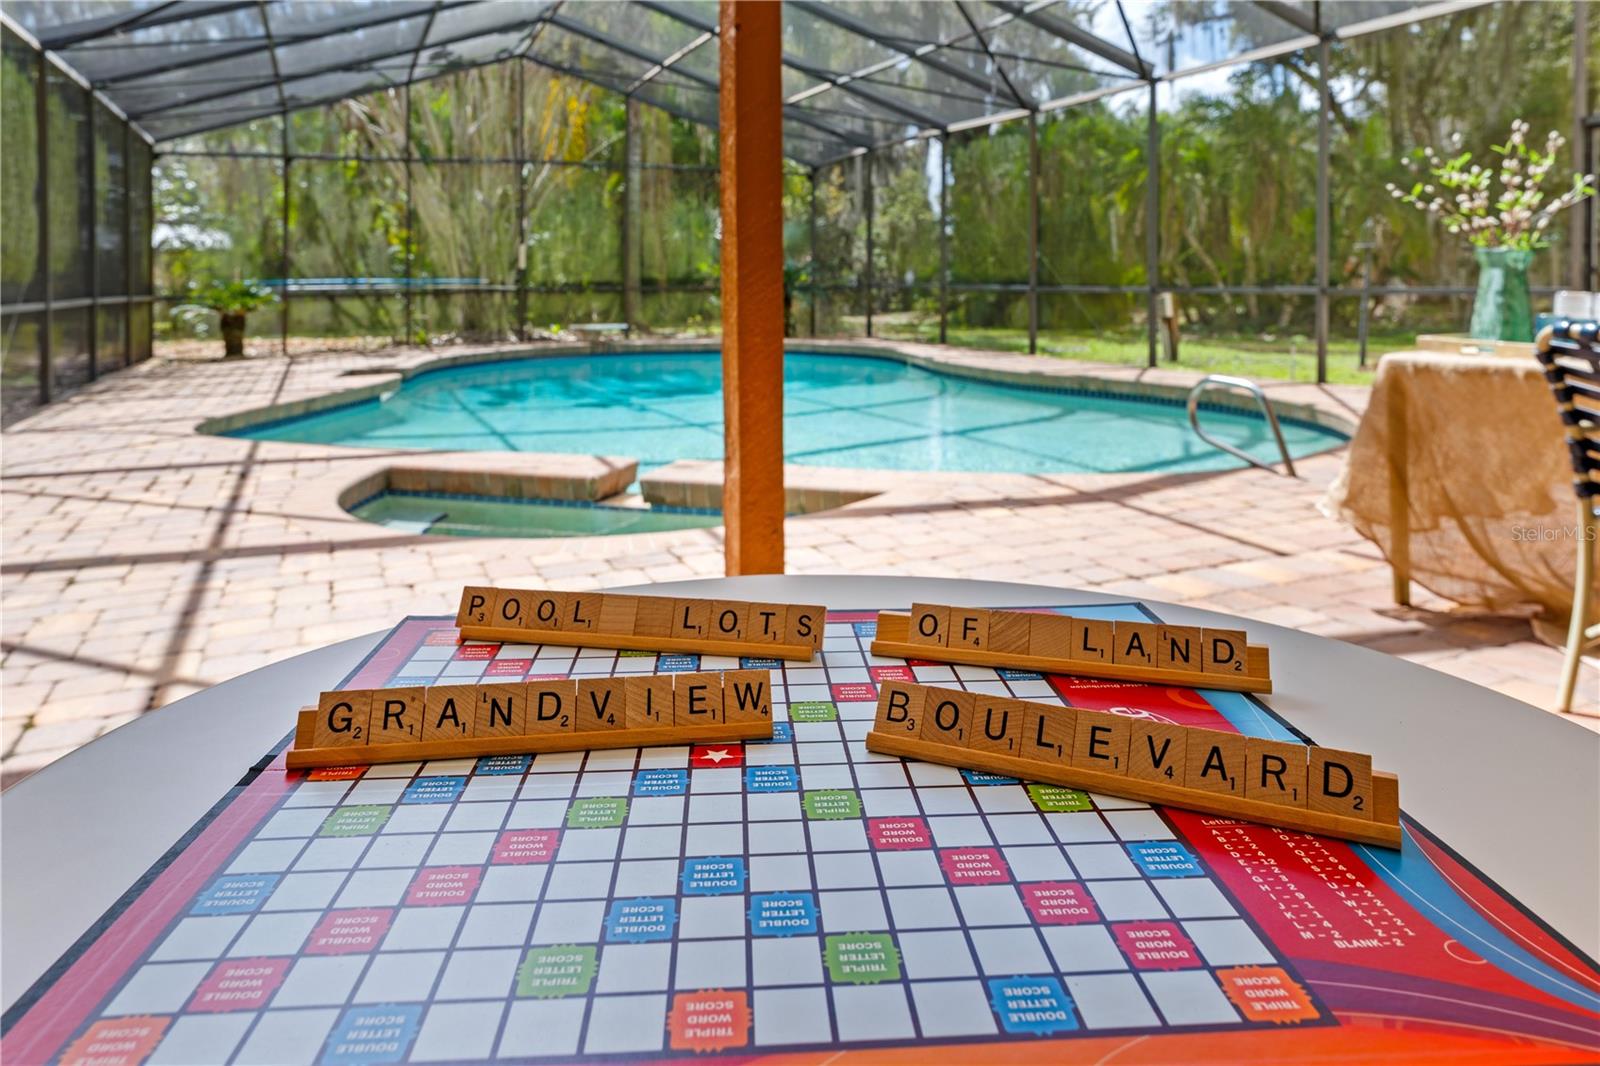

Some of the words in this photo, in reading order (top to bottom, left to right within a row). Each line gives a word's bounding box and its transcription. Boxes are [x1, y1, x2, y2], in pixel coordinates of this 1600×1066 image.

[467, 596, 586, 624] POOL
[683, 606, 812, 636] LOTS
[918, 614, 978, 640] OF
[1083, 626, 1234, 664] LAND
[328, 682, 765, 735] GRANDVIEW
[886, 691, 1354, 799] BOULEVARD
[416, 889, 467, 897] DOUBLE
[763, 899, 804, 907] SCORE
[334, 916, 381, 924] SCORE
[760, 918, 810, 926] DOUBLE
[616, 924, 667, 932] DOUBLE
[1125, 929, 1171, 937] SCORE
[317, 935, 374, 944] DOUBLE
[1133, 939, 1176, 948] WORD
[1332, 939, 1384, 948] BLANK
[1390, 938, 1406, 946] 2
[839, 941, 884, 949] SCORE
[538, 954, 585, 962] SCORE
[840, 952, 887, 960] LETTER
[1134, 950, 1189, 959] DOUBLE
[223, 966, 276, 976] SCORE
[534, 965, 584, 974] LETTER
[842, 963, 889, 972] TRIPLE
[217, 978, 266, 987] WORD
[531, 977, 580, 986] TRIPLE
[1231, 975, 1281, 985] SCORE
[201, 990, 264, 1000] DOUBLE
[1003, 985, 1053, 995] SCORE
[1242, 987, 1289, 997] WORD
[687, 1000, 736, 1010] SCORE
[1007, 998, 1059, 1008] LETTER
[1249, 1000, 1301, 1010] TRIPLE
[353, 1015, 408, 1025] SCORE
[689, 1013, 733, 1023] WORD
[1009, 1010, 1068, 1021] DOUBLE
[92, 1027, 151, 1037] SCORE
[346, 1028, 403, 1038] LETTER
[686, 1026, 736, 1037] TRIPLE
[82, 1041, 138, 1052] WORD
[335, 1042, 400, 1053] DOUBLE
